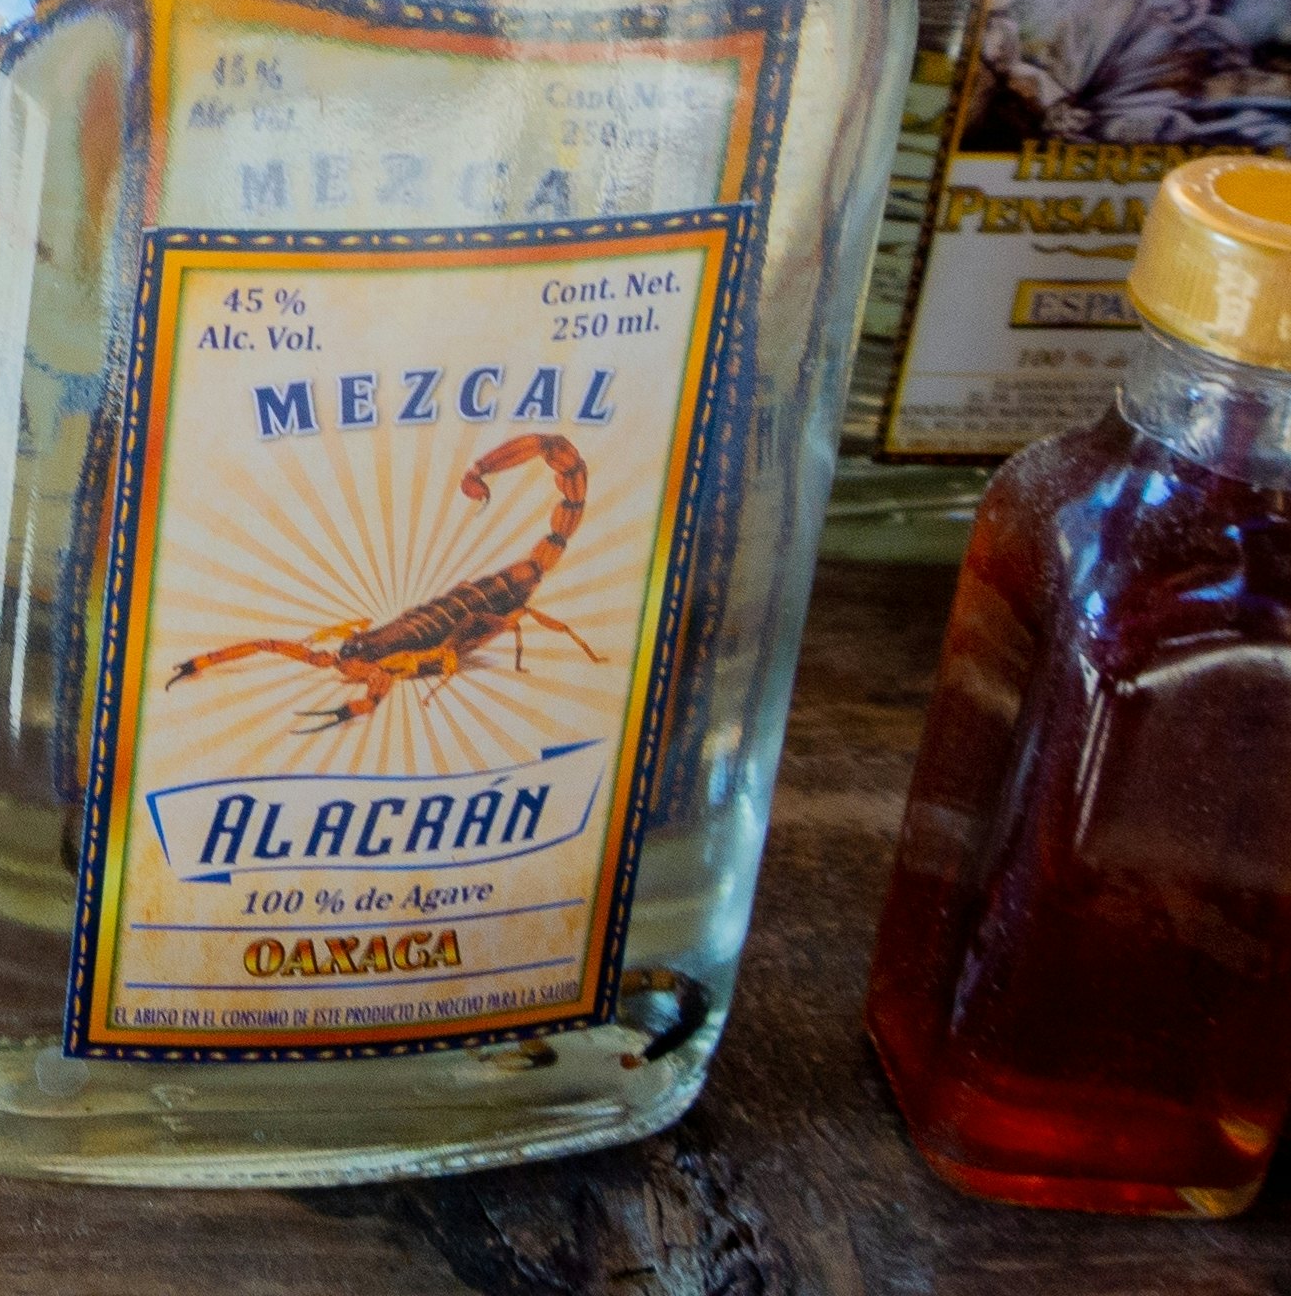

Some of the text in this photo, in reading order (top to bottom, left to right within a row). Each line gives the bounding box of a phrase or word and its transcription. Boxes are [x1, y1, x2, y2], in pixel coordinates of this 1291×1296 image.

[223, 287, 306, 317] 45 %
[541, 270, 682, 307] Cont. Net.
[197, 325, 322, 353] Alc. Vol.
[552, 306, 660, 343] 250 ml.
[252, 365, 623, 441] MEZCAL
[200, 777, 552, 864] ALACRÁN
[240, 879, 494, 915] 100 % de Agave
[243, 929, 462, 978] OAXACA
[133, 1008, 179, 1026] ABUSO
[182, 1008, 199, 1026] EN
[221, 1009, 290, 1027] CONSUMO
[293, 1008, 308, 1026] DE
[312, 1005, 342, 1025] ESTE
[345, 1004, 414, 1025] PRODUCTO
[435, 998, 484, 1019] NOCIVO
[486, 991, 517, 1012] PARA
